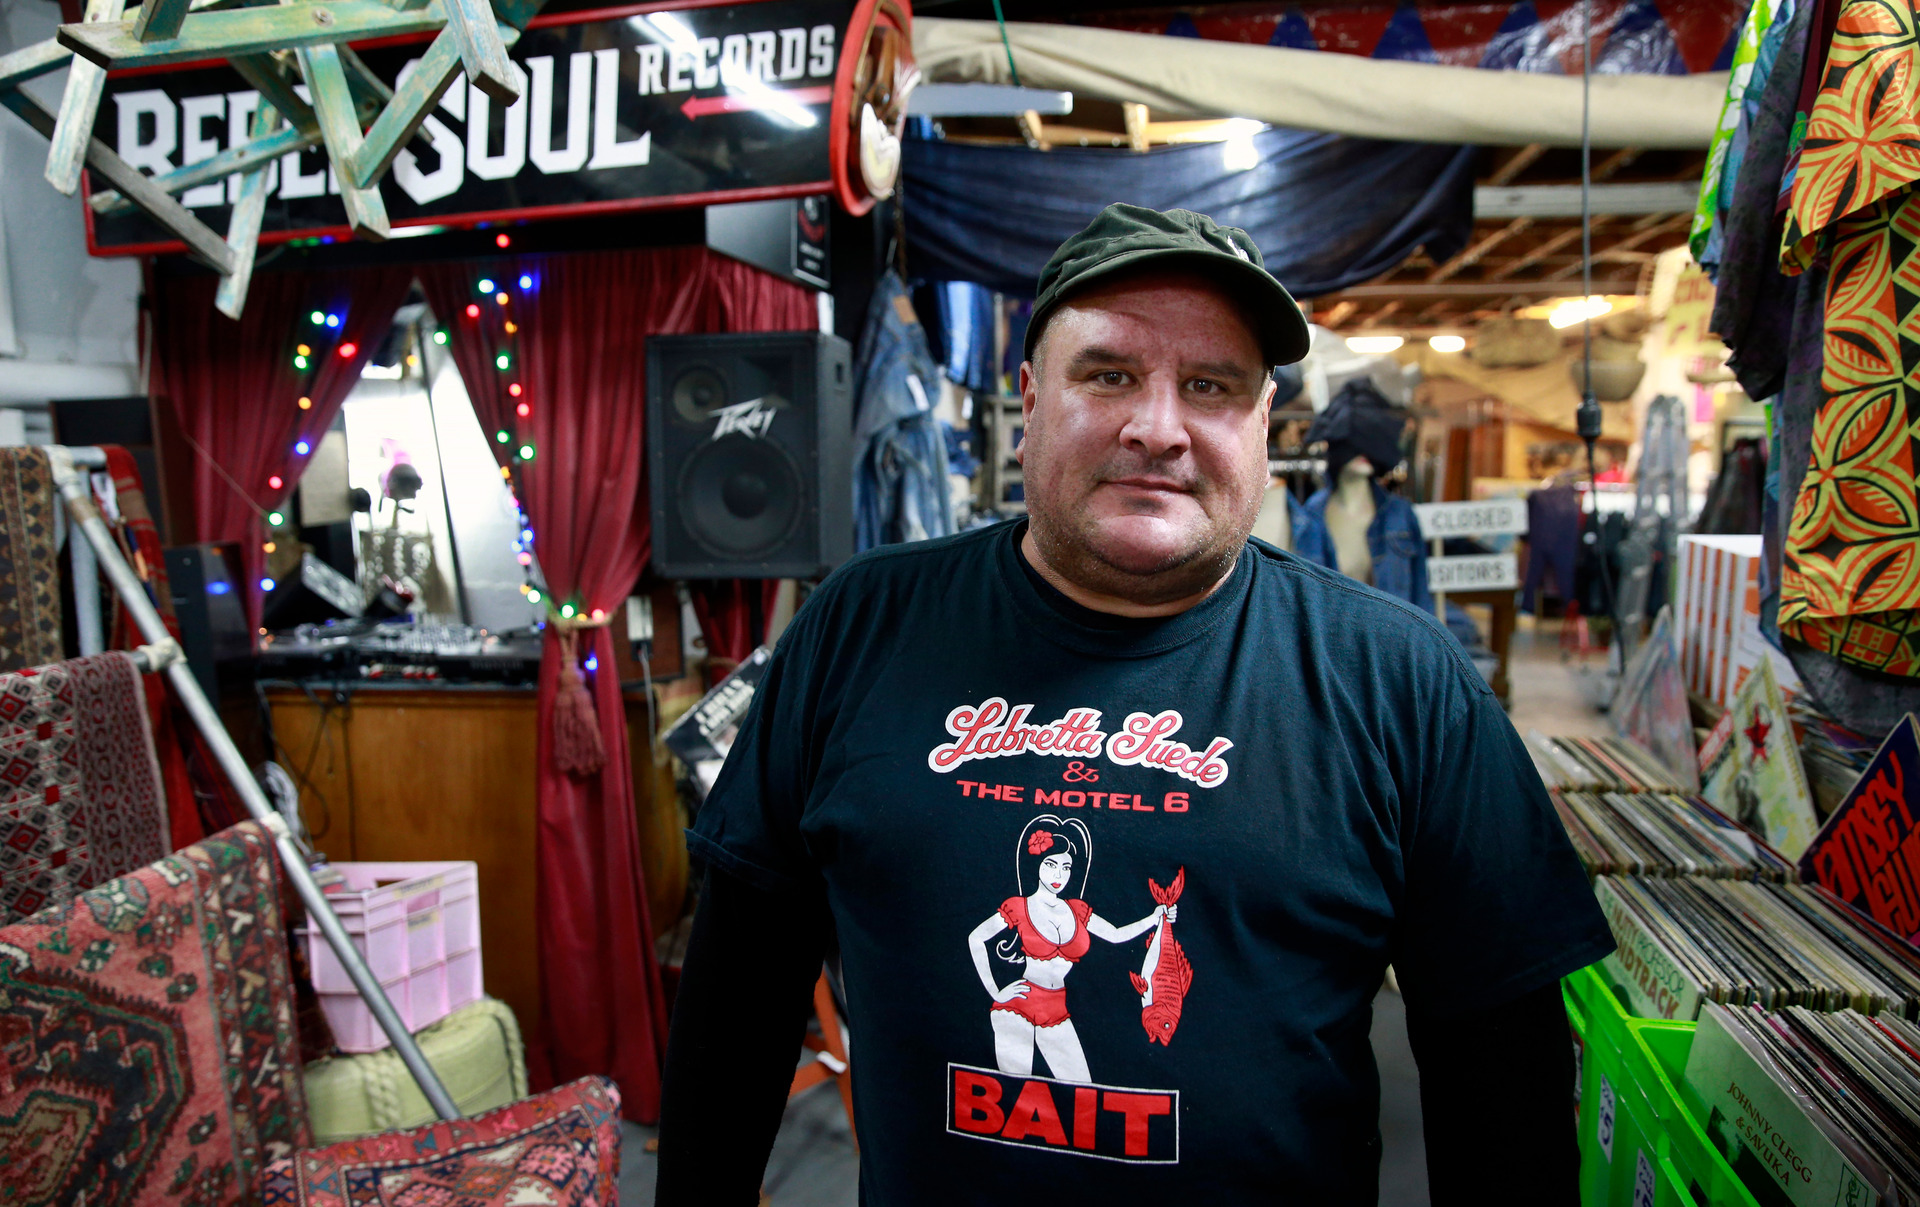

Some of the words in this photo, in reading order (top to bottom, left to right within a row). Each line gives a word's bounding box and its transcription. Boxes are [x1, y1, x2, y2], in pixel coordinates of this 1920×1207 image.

[635, 24, 836, 96] RECORDS
[393, 48, 651, 206] SOUL
[1431, 506, 1512, 532] CLOSED
[931, 699, 1105, 770] Labretta
[1108, 712, 1231, 785] Suede
[1062, 761, 1099, 783] &
[956, 780, 1024, 803] THE
[1034, 788, 1155, 812] MOTEL
[1163, 792, 1190, 813] 6
[954, 1069, 1171, 1156] BAIT
[1726, 1082, 1773, 1138] JOHNNY
[1771, 1132, 1813, 1184] CLEGG
[1735, 1116, 1746, 1130] &
[1744, 1126, 1791, 1187] SAVUKA
